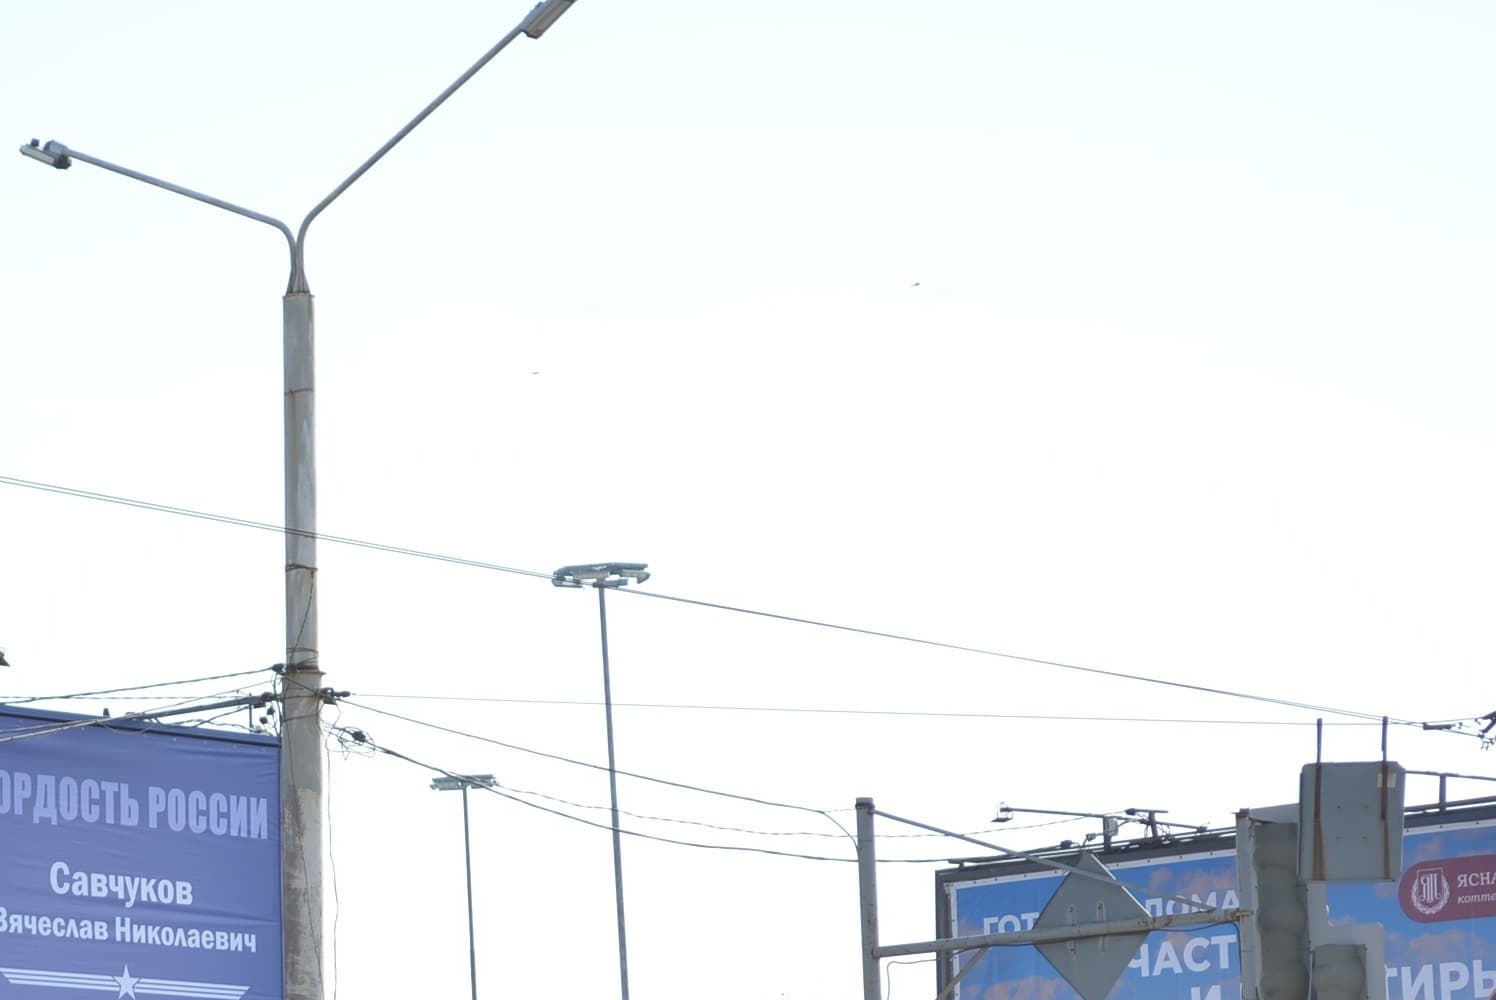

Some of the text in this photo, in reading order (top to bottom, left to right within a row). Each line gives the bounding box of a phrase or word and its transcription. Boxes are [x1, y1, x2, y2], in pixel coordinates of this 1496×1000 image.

[148, 786, 268, 839] РОССИИ
[50, 862, 193, 908] Савчуков
[115, 917, 256, 952] Николаевич
